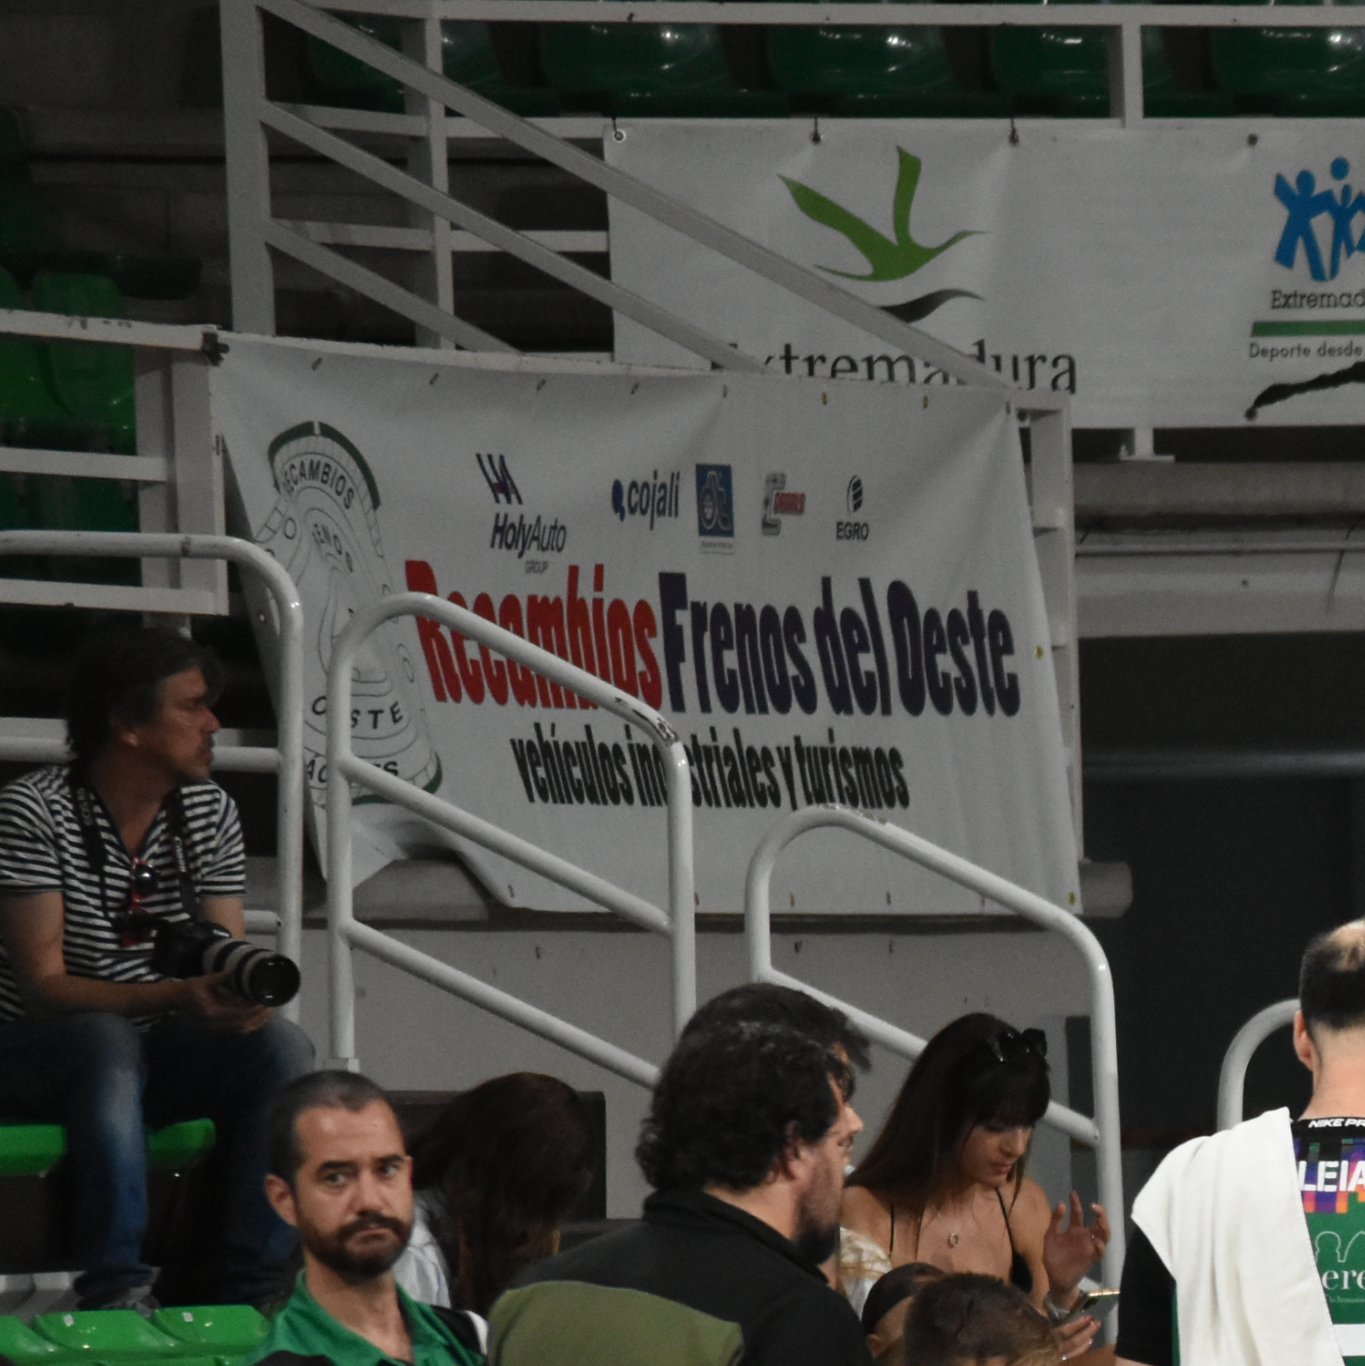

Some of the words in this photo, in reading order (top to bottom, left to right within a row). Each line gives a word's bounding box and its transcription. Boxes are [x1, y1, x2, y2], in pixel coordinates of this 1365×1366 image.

[1250, 341, 1312, 361] Deporte
[1317, 339, 1363, 358] desde
[627, 469, 680, 531] cojali
[490, 512, 568, 560] HolyAuto
[836, 521, 869, 542] EGRO
[405, 560, 663, 711] Recambios
[658, 572, 817, 715] Frenos
[813, 575, 892, 716] del
[886, 579, 1021, 716] Oeste
[510, 721, 635, 807] vehículos
[776, 744, 799, 812] y
[793, 728, 912, 811] turismos
[1308, 1119, 1344, 1129] NIKE
